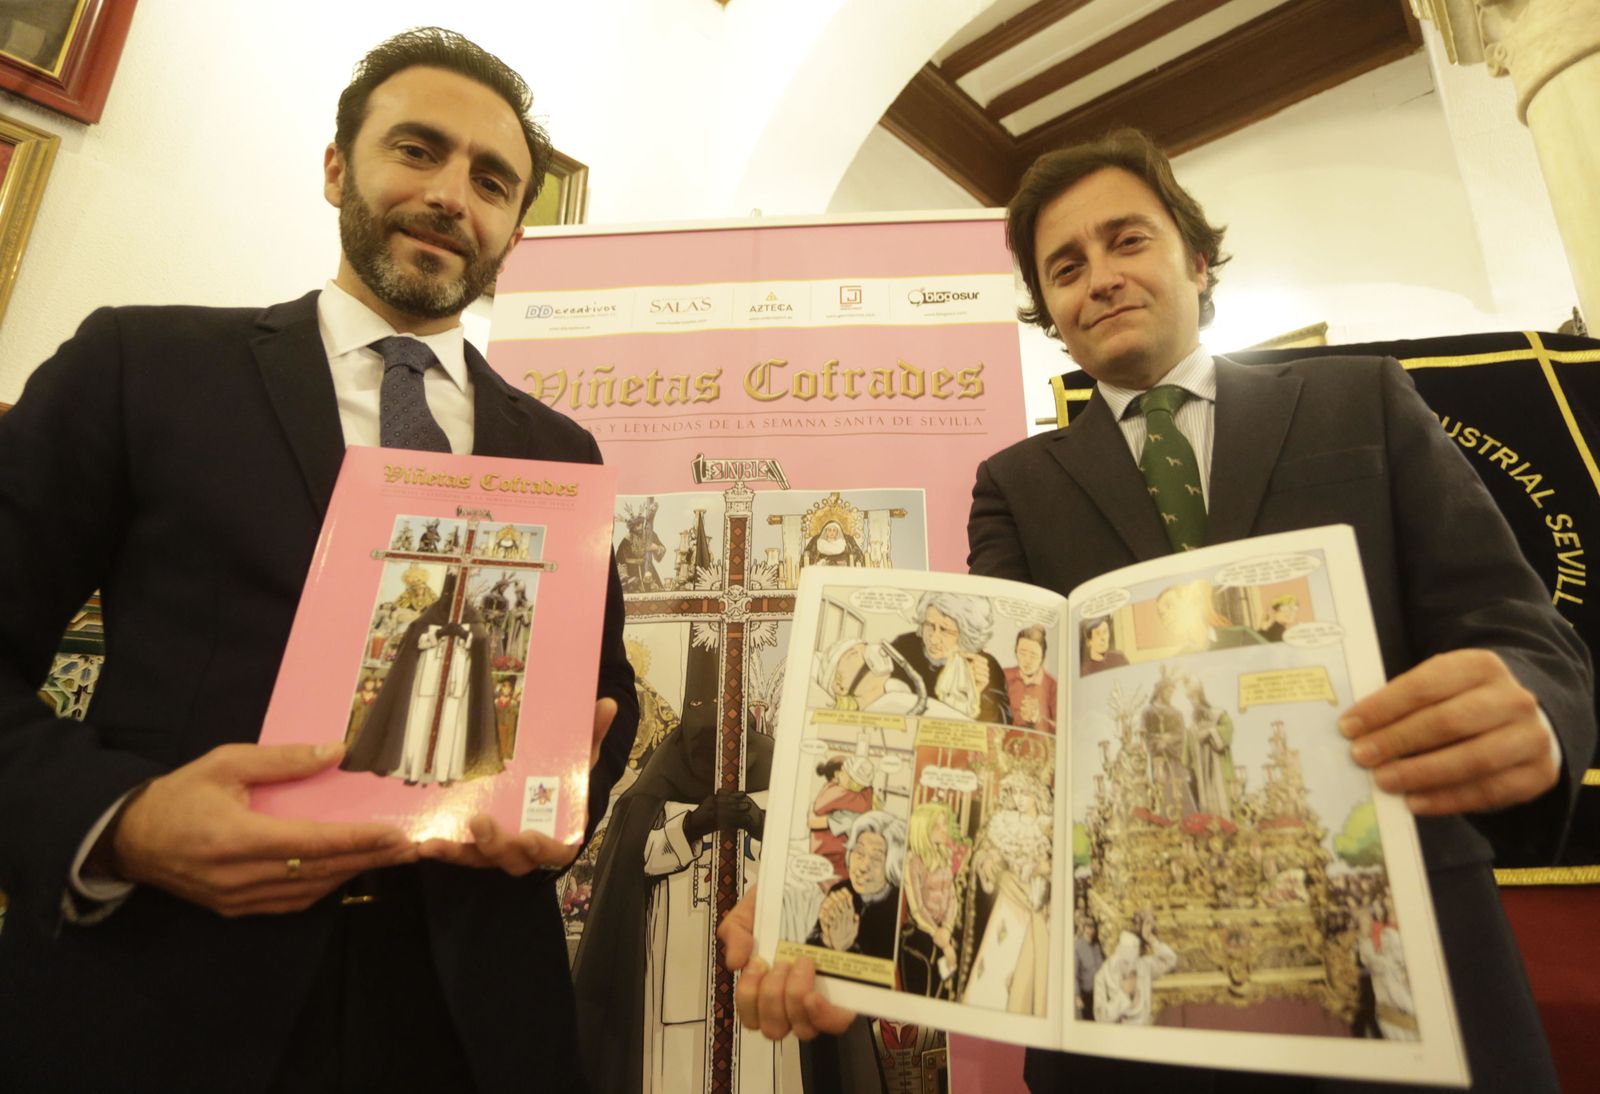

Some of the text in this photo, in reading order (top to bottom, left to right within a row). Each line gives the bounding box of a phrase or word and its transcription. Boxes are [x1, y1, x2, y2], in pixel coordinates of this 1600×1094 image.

[650, 298, 712, 313] SALAS
[749, 303, 794, 313] AZTECA
[523, 358, 986, 411] Viñetas Cofrades
[609, 422, 617, 433] Y
[623, 419, 702, 433] LEYENDAS
[709, 417, 730, 430] DE
[737, 418, 756, 430] LA
[762, 416, 827, 429] SEMANA
[834, 415, 885, 428] SANTA
[892, 415, 913, 427] DE
[920, 415, 984, 428] SEVILLA
[384, 464, 579, 497] Viñetas Cofrades
[1433, 411, 1587, 630] USTRIAL SEVILL
